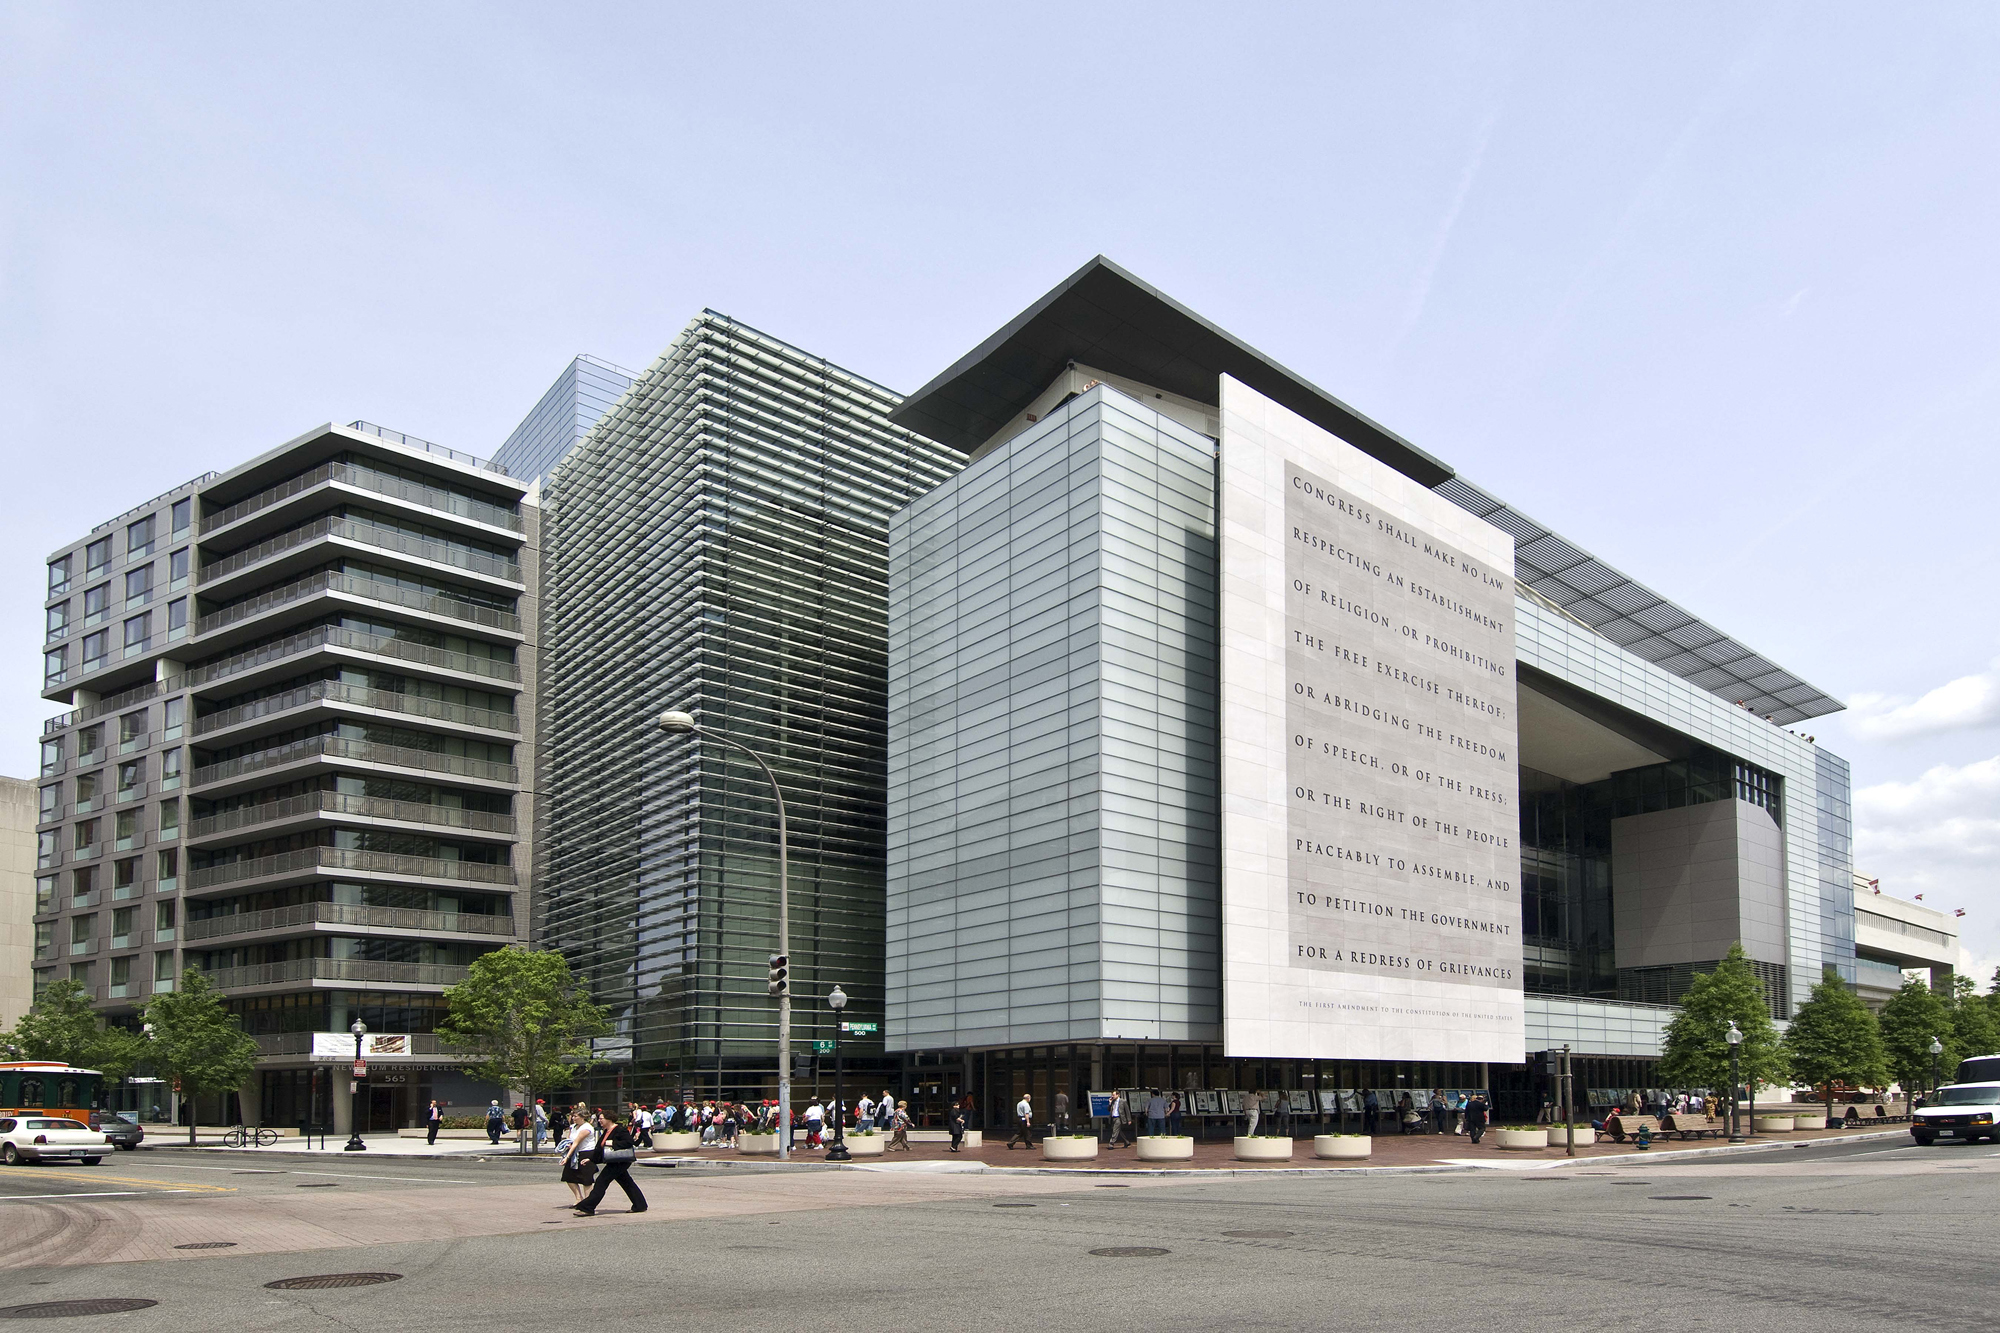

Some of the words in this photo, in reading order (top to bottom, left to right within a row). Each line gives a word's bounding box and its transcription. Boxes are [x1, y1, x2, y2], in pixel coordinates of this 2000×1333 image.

[1293, 476, 1371, 524] CONGRESS
[1378, 519, 1417, 548] SHALL
[1423, 543, 1455, 568] MAKE
[1462, 562, 1478, 578] NO
[1483, 573, 1504, 591] LAW
[1293, 527, 1381, 577] RESPECTING
[1387, 572, 1404, 587] AN
[1411, 582, 1504, 633] ESTABLISHMENT
[1293, 579, 1311, 595] OF
[1321, 590, 1398, 632] RELIGION,
[1402, 625, 1418, 641] OR
[1425, 634, 1505, 676] PROHIBITING
[1294, 630, 1324, 651] THE
[1335, 646, 1368, 668] FREE
[1377, 662, 1439, 695] EXERCISE
[1447, 688, 1506, 720] THEREOF;
[1294, 682, 1315, 699] OR
[1323, 692, 1410, 730] ABRIDGING
[1417, 723, 1442, 741] THE
[1450, 735, 1506, 762] FREEDOM
[1295, 734, 1314, 749] OF
[1323, 743, 1384, 770] SPEECH,
[1391, 762, 1409, 777] OR
[1416, 769, 1431, 783] OF
[1438, 775, 1462, 792] THE
[1469, 785, 1507, 805] PRESS;
[1295, 786, 1316, 801] OR
[1323, 793, 1351, 810] THE
[1360, 802, 1405, 823] RIGHT
[1412, 815, 1428, 828] OF
[1435, 821, 1459, 836] THE
[1466, 829, 1508, 848] PEOPLE
[1296, 838, 1380, 866] PEACEABLY
[1388, 857, 1405, 871] TO
[1412, 863, 1480, 887] ASSEMBLE,
[1486, 878, 1510, 892] AND
[1297, 892, 1316, 905] TO
[1326, 896, 1393, 917] PETITION
[1401, 908, 1425, 922] THE
[1431, 913, 1510, 935] GOVERNMENT
[1298, 945, 1328, 960] FOR
[1334, 949, 1343, 961] A
[1351, 951, 1410, 969] REDRESS
[1417, 958, 1433, 971] OF
[1439, 961, 1512, 980] GRIEVANCES
[1337, 1003, 1379, 1012] AMENDMENT
[1405, 1008, 1450, 1017] CONSTITUTION
